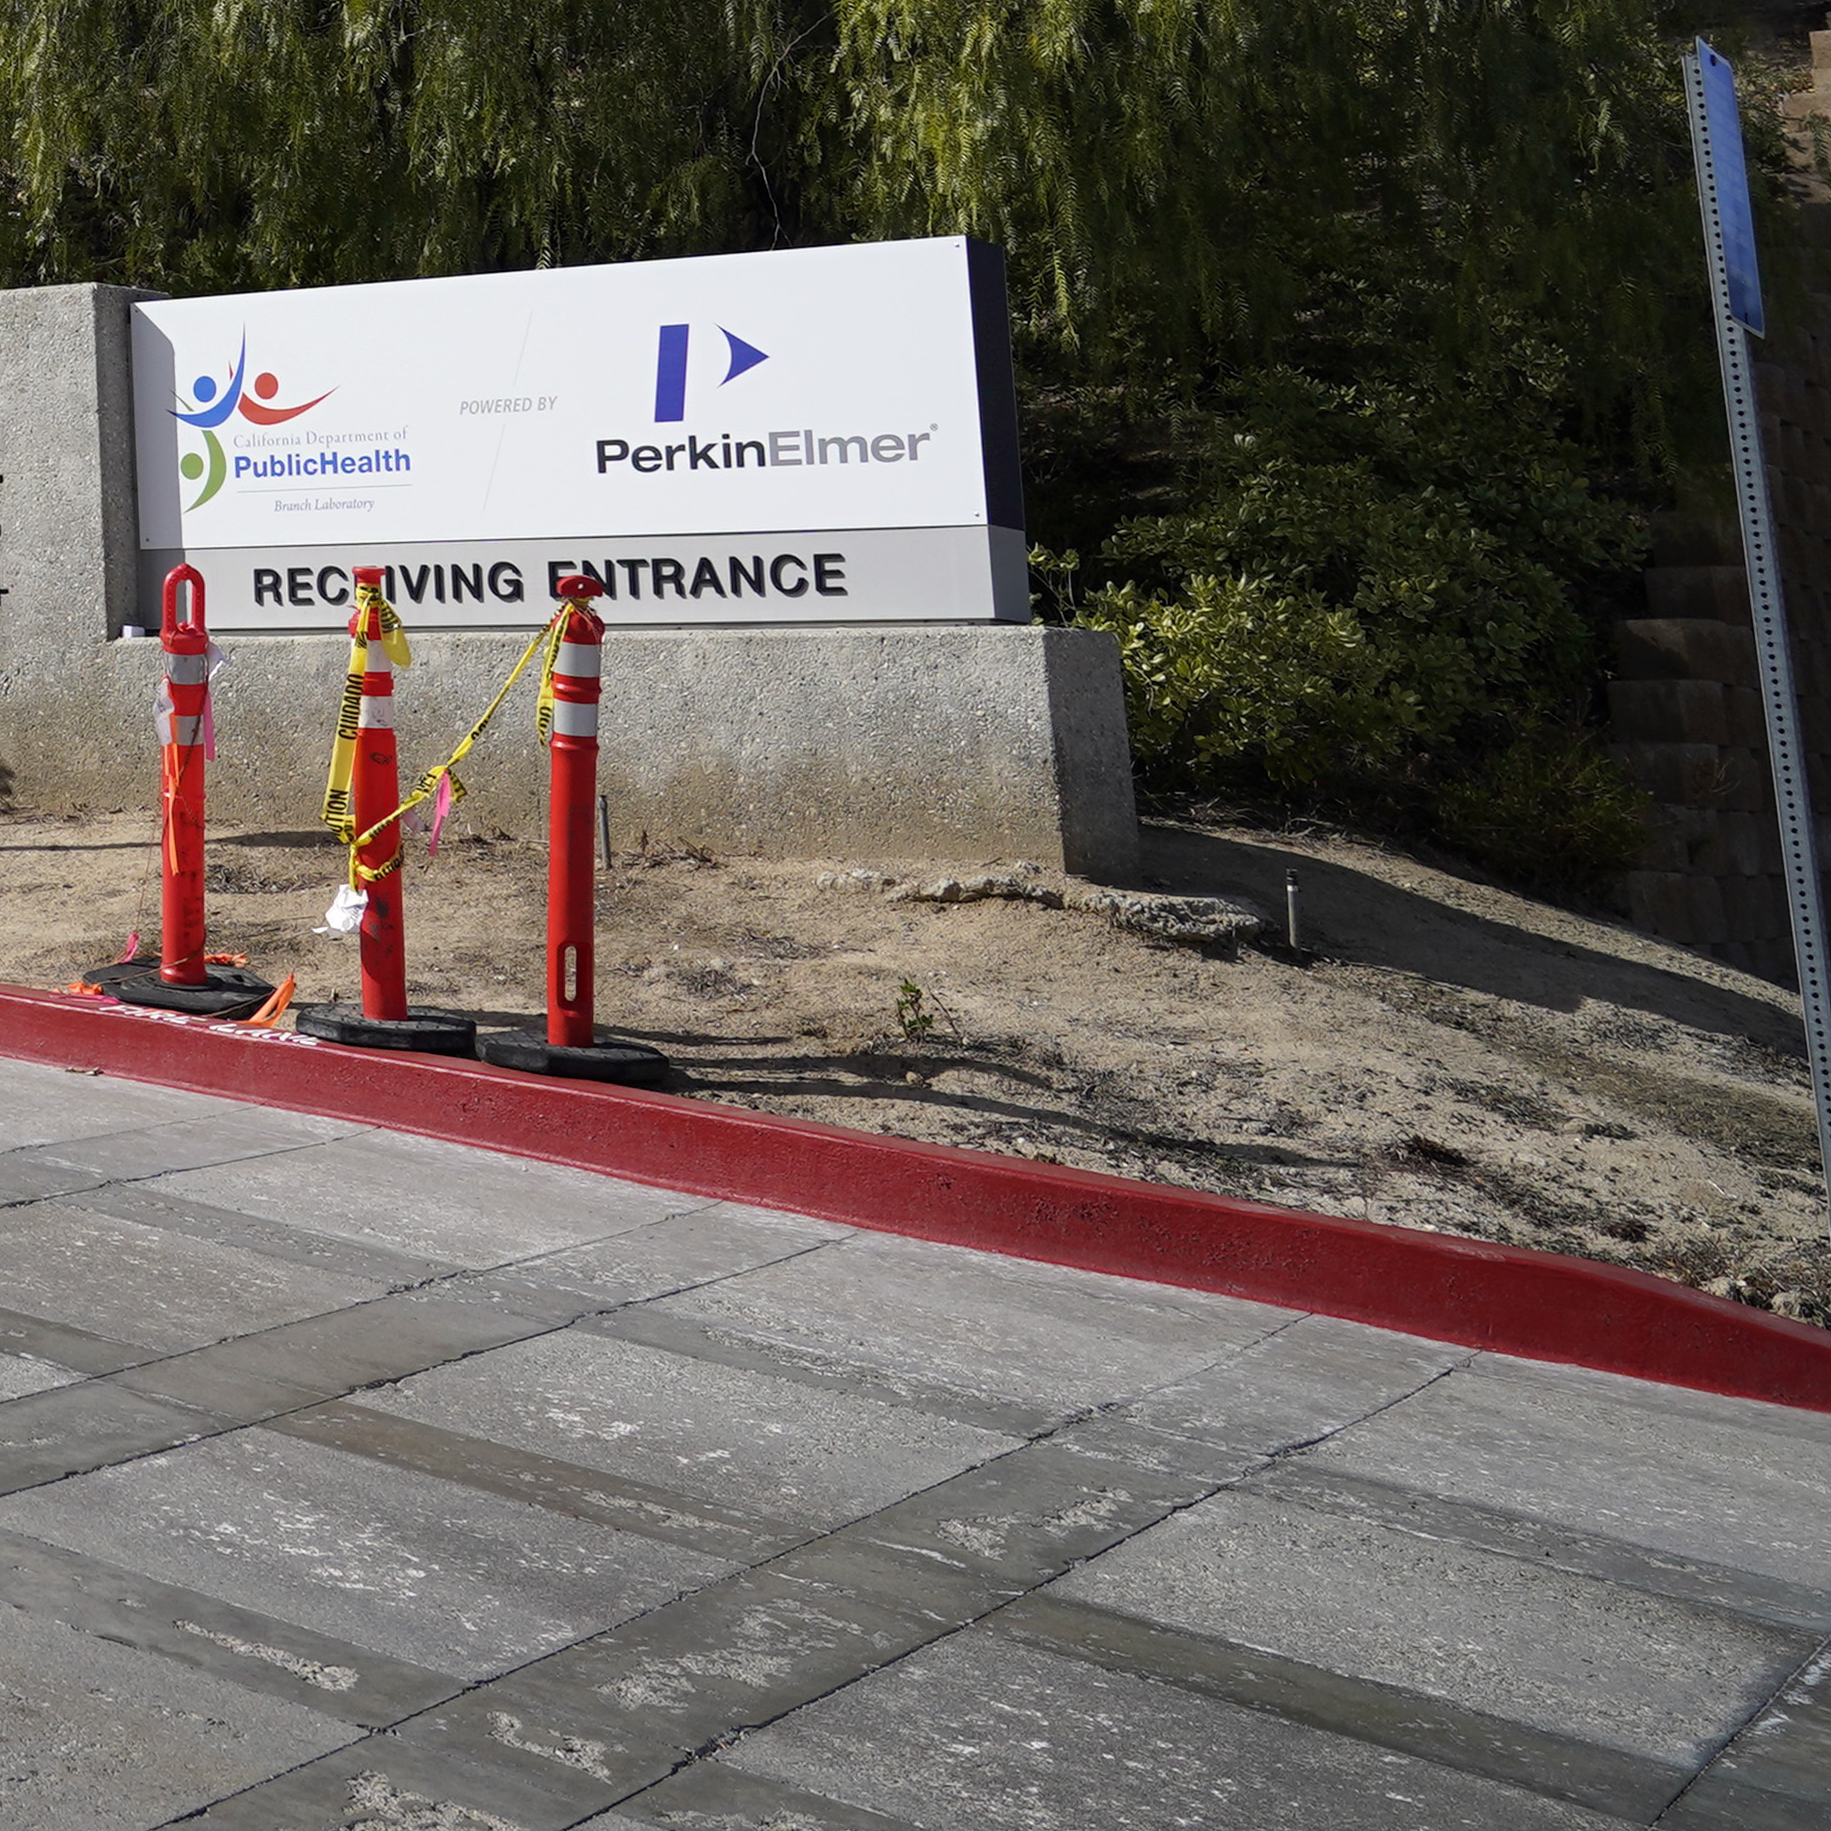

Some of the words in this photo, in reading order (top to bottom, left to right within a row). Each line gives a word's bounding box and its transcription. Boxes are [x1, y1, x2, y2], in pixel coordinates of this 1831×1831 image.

[459, 397, 533, 415] POWERED
[537, 395, 558, 411] BY
[233, 432, 302, 448] California
[305, 430, 389, 449] Department
[393, 425, 410, 440] of
[234, 448, 412, 479] PublicHealth
[596, 428, 931, 474] PerkinElmer
[274, 498, 312, 512] Branch
[314, 497, 375, 513] Laboratory
[253, 560, 525, 607] RECIVING
[338, 673, 365, 740] CUIDADO
[209, 1023, 321, 1046] LANE
